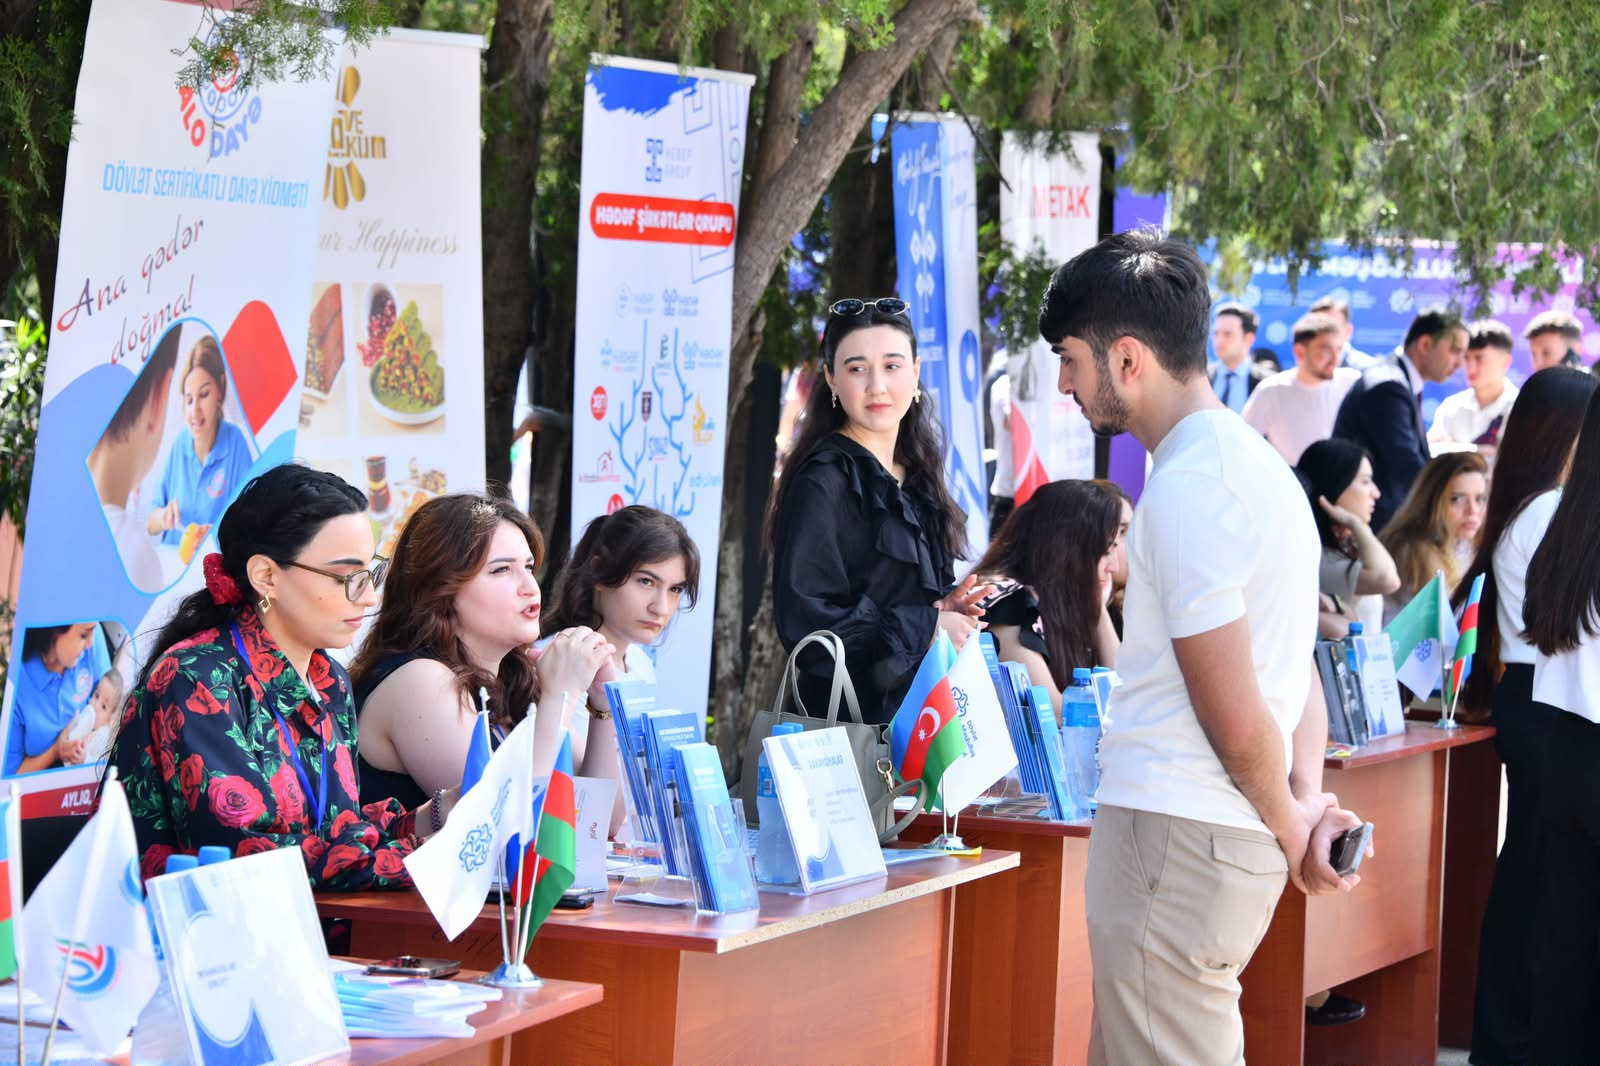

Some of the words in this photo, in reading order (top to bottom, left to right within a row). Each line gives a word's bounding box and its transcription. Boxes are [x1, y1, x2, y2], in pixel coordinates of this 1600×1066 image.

[179, 85, 206, 147] ALO
[103, 160, 153, 195] DÖVLƏT
[347, 217, 457, 271] Happiness
[595, 205, 636, 227] HƏDƏF
[57, 276, 127, 332] Ana
[141, 213, 204, 294] qədər
[111, 273, 194, 365] doğma!
